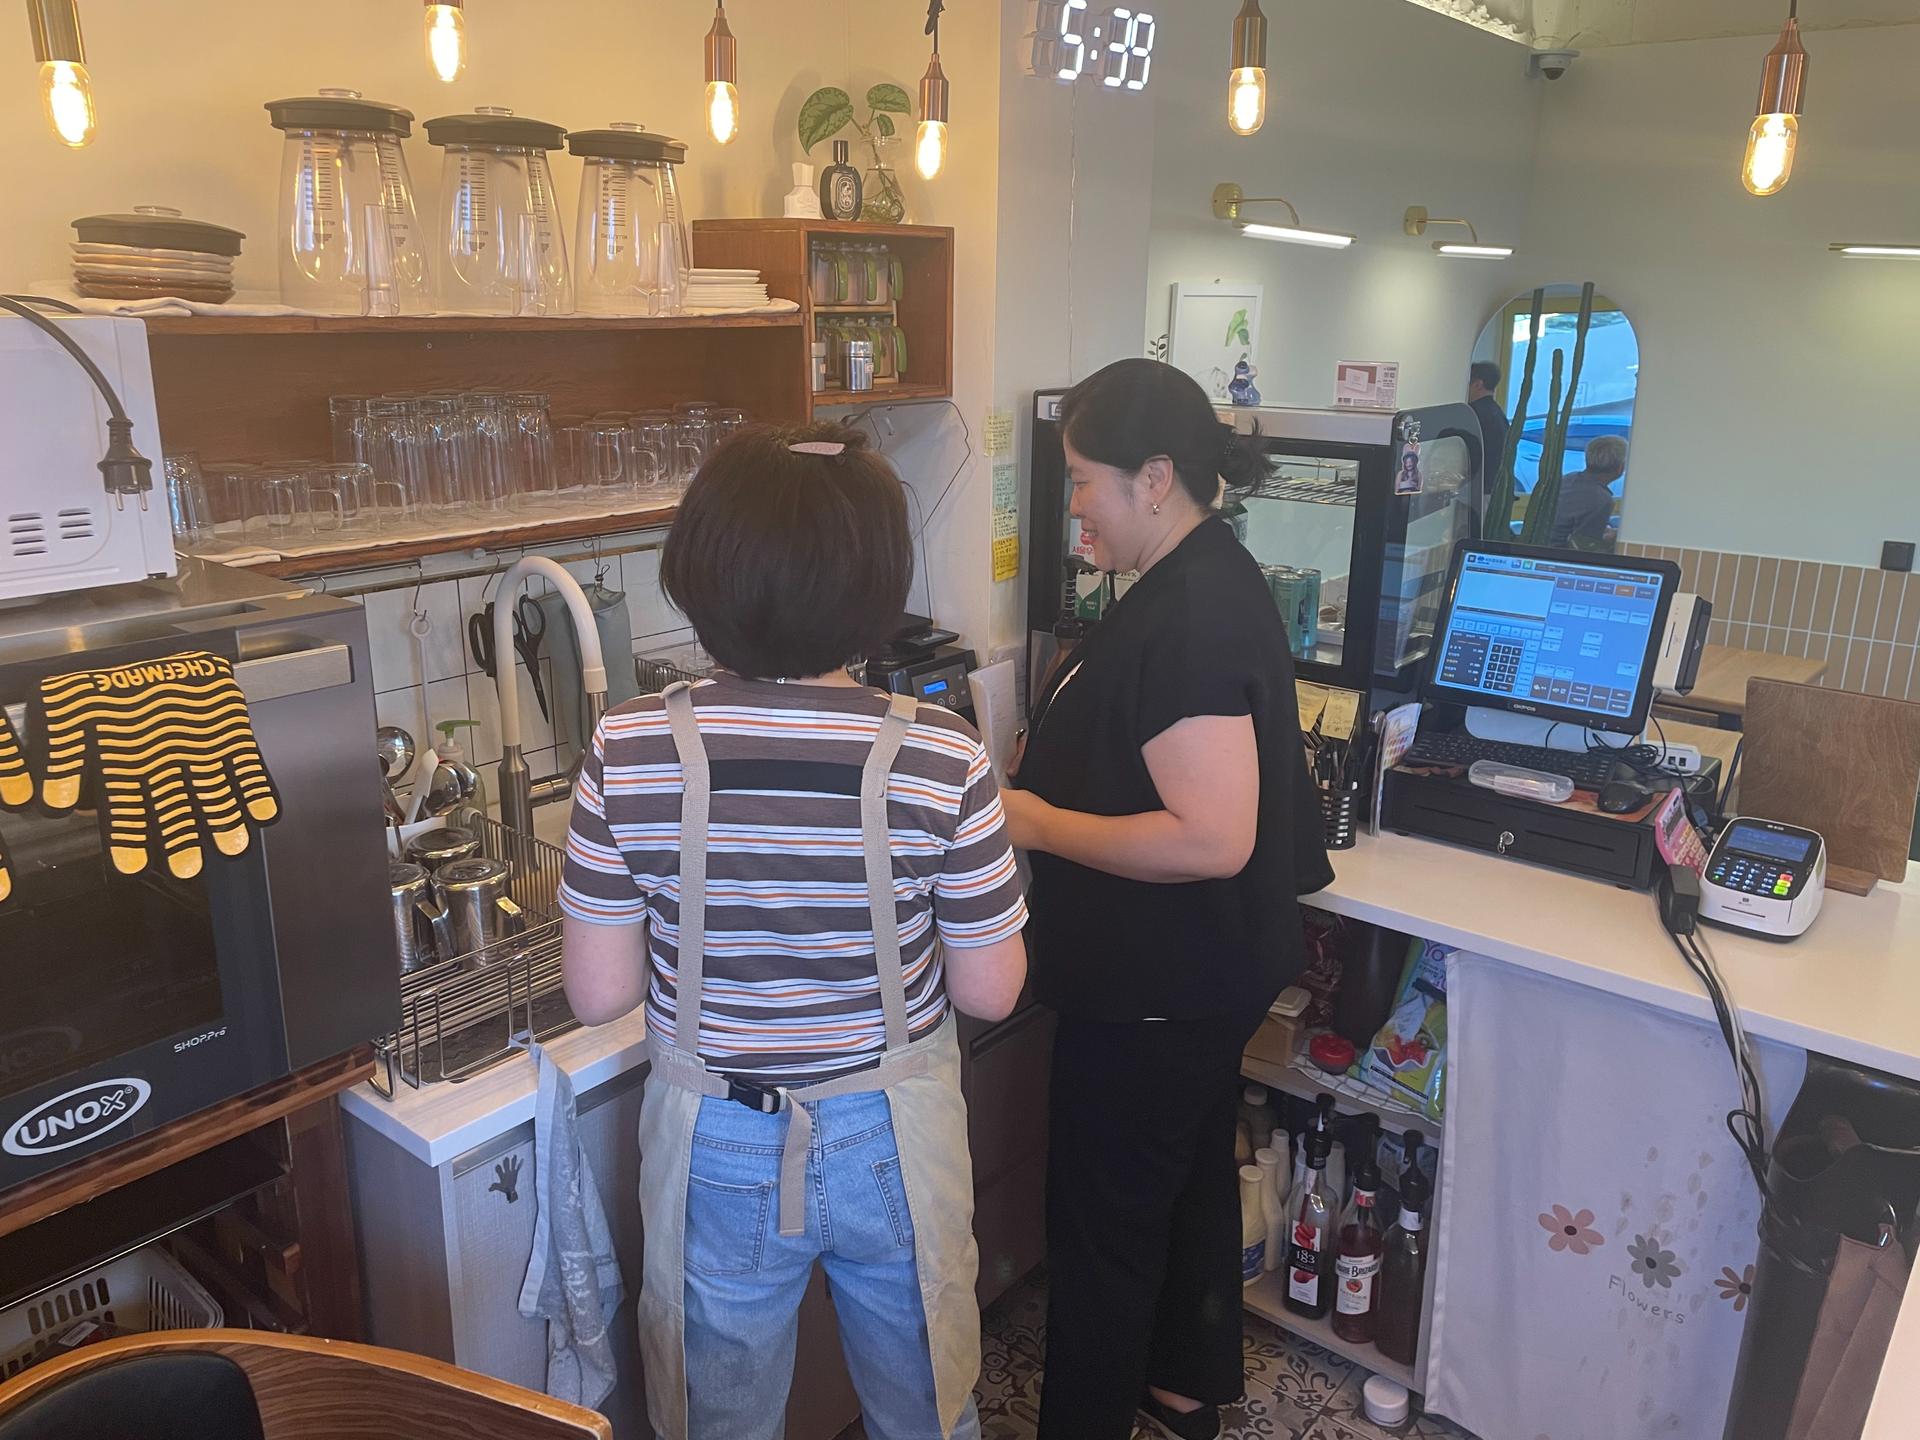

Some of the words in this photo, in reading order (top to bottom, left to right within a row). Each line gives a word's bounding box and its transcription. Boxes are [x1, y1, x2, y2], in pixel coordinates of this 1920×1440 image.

[1057, 0, 1156, 91] 5:39
[93, 659, 217, 692] CHEFMADE
[20, 1089, 127, 1146] UNOX
[1608, 1274, 1686, 1325] Flowers
